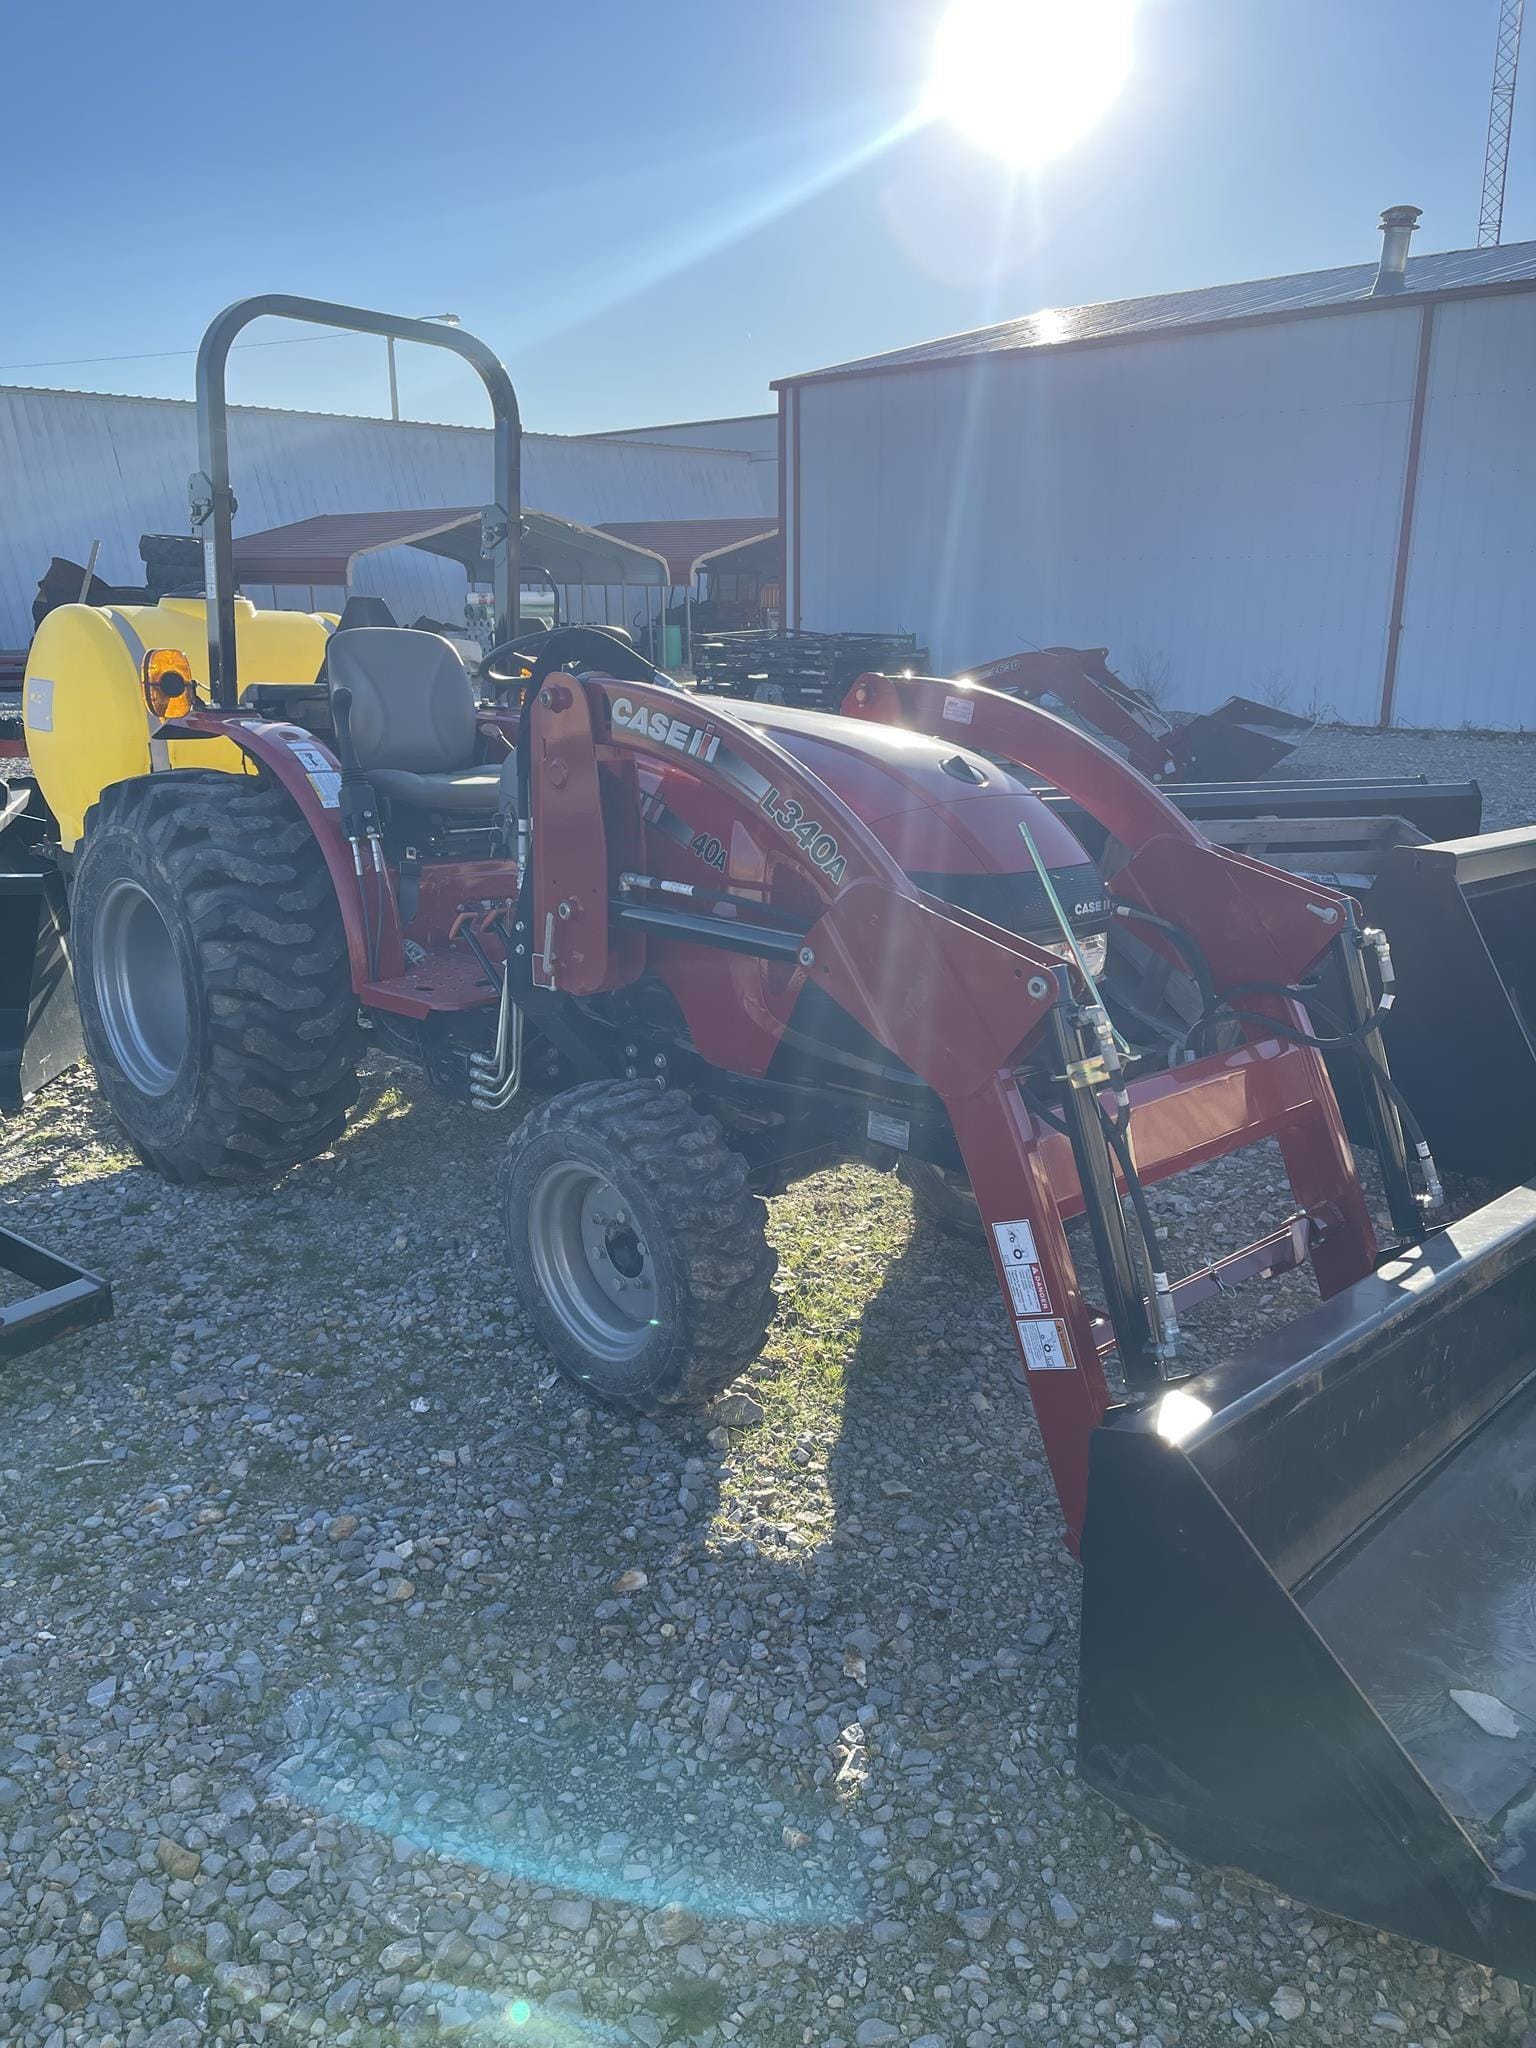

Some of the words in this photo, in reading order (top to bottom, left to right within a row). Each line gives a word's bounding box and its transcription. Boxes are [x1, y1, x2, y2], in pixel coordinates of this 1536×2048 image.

[690, 832, 727, 873] 40A
[760, 787, 848, 885] L340A
[1074, 901, 1101, 916] CASE
[1034, 1274, 1049, 1310] DANGER
